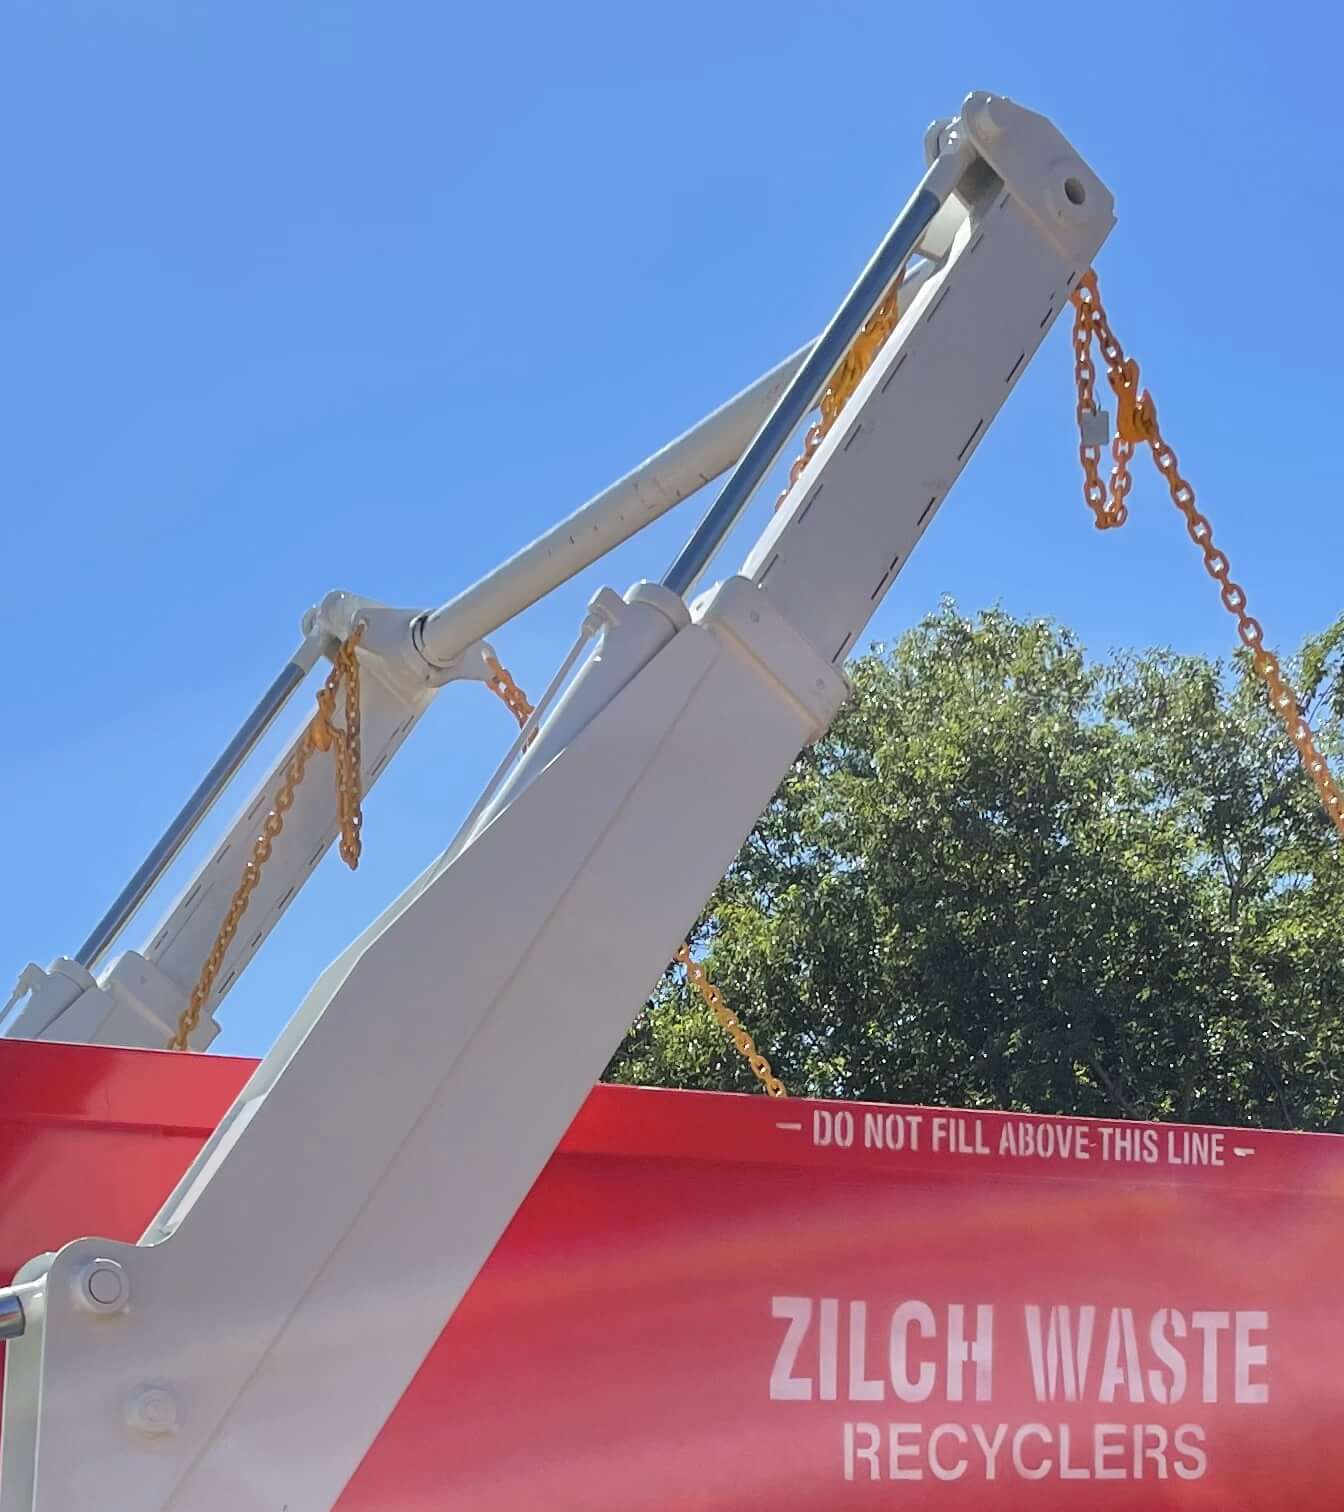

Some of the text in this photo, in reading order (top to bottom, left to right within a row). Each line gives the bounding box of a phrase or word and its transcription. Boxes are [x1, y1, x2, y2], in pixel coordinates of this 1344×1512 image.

[813, 1109, 1225, 1166] DO NOT FILL ABOVE THIS LINE
[769, 1296, 1269, 1404] ZILCH WASTE
[843, 1422, 1208, 1481] RECYCLERS
